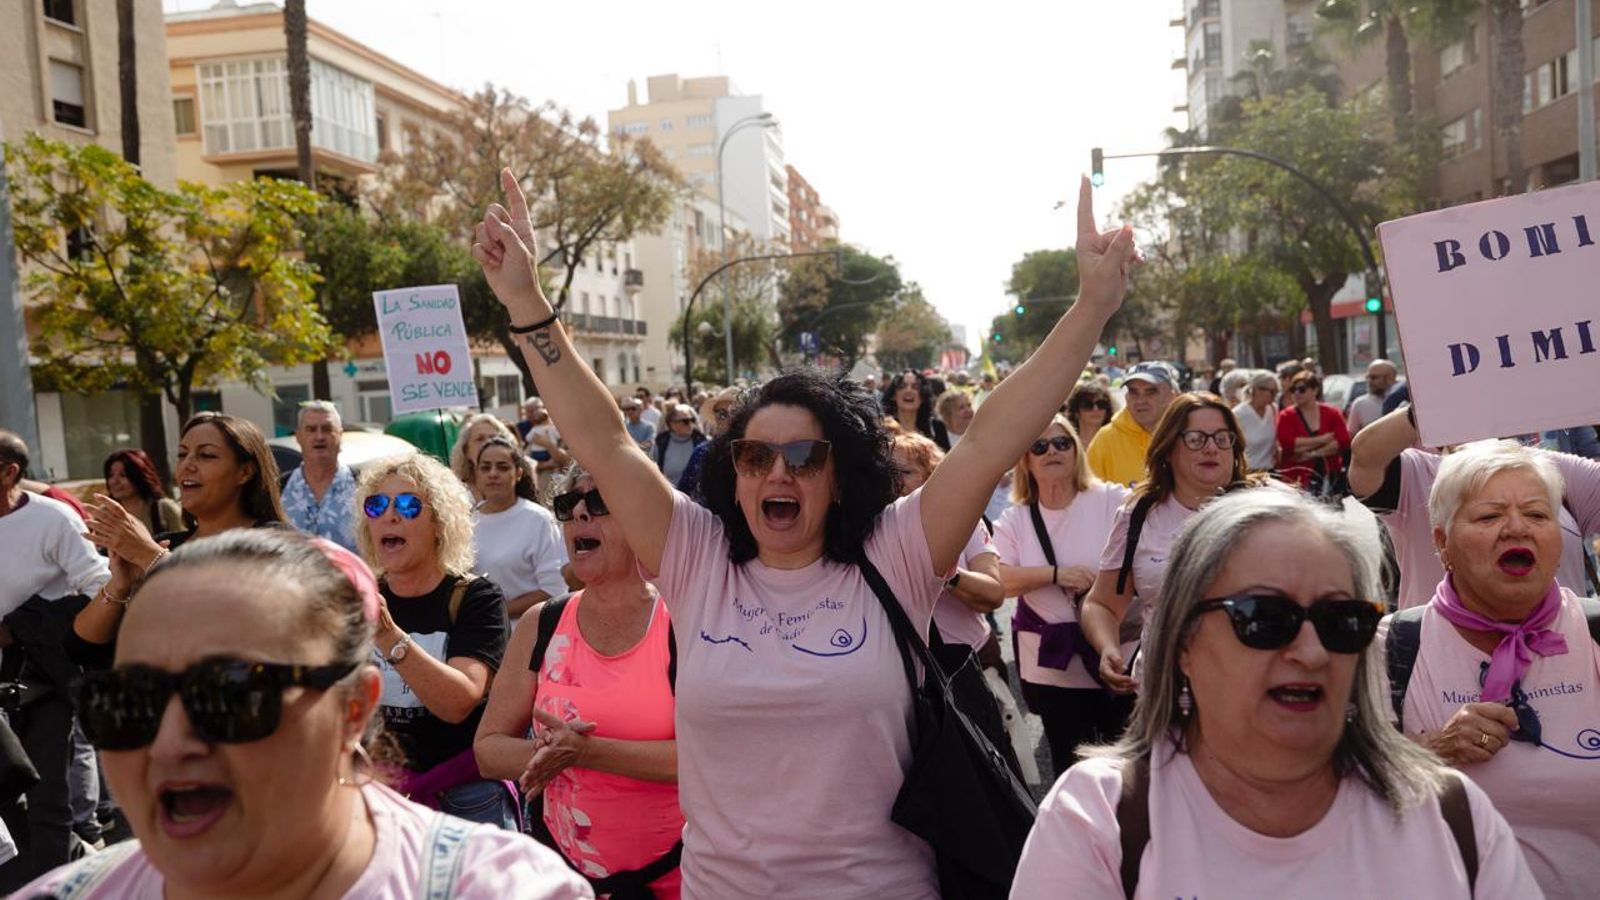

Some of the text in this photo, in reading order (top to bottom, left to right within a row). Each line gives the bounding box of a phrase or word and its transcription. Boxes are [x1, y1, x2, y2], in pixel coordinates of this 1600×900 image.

[1434, 215, 1594, 273] BONI
[415, 350, 452, 375] NO
[1448, 320, 1596, 377] DIMI
[401, 381, 477, 402] SE VENDE
